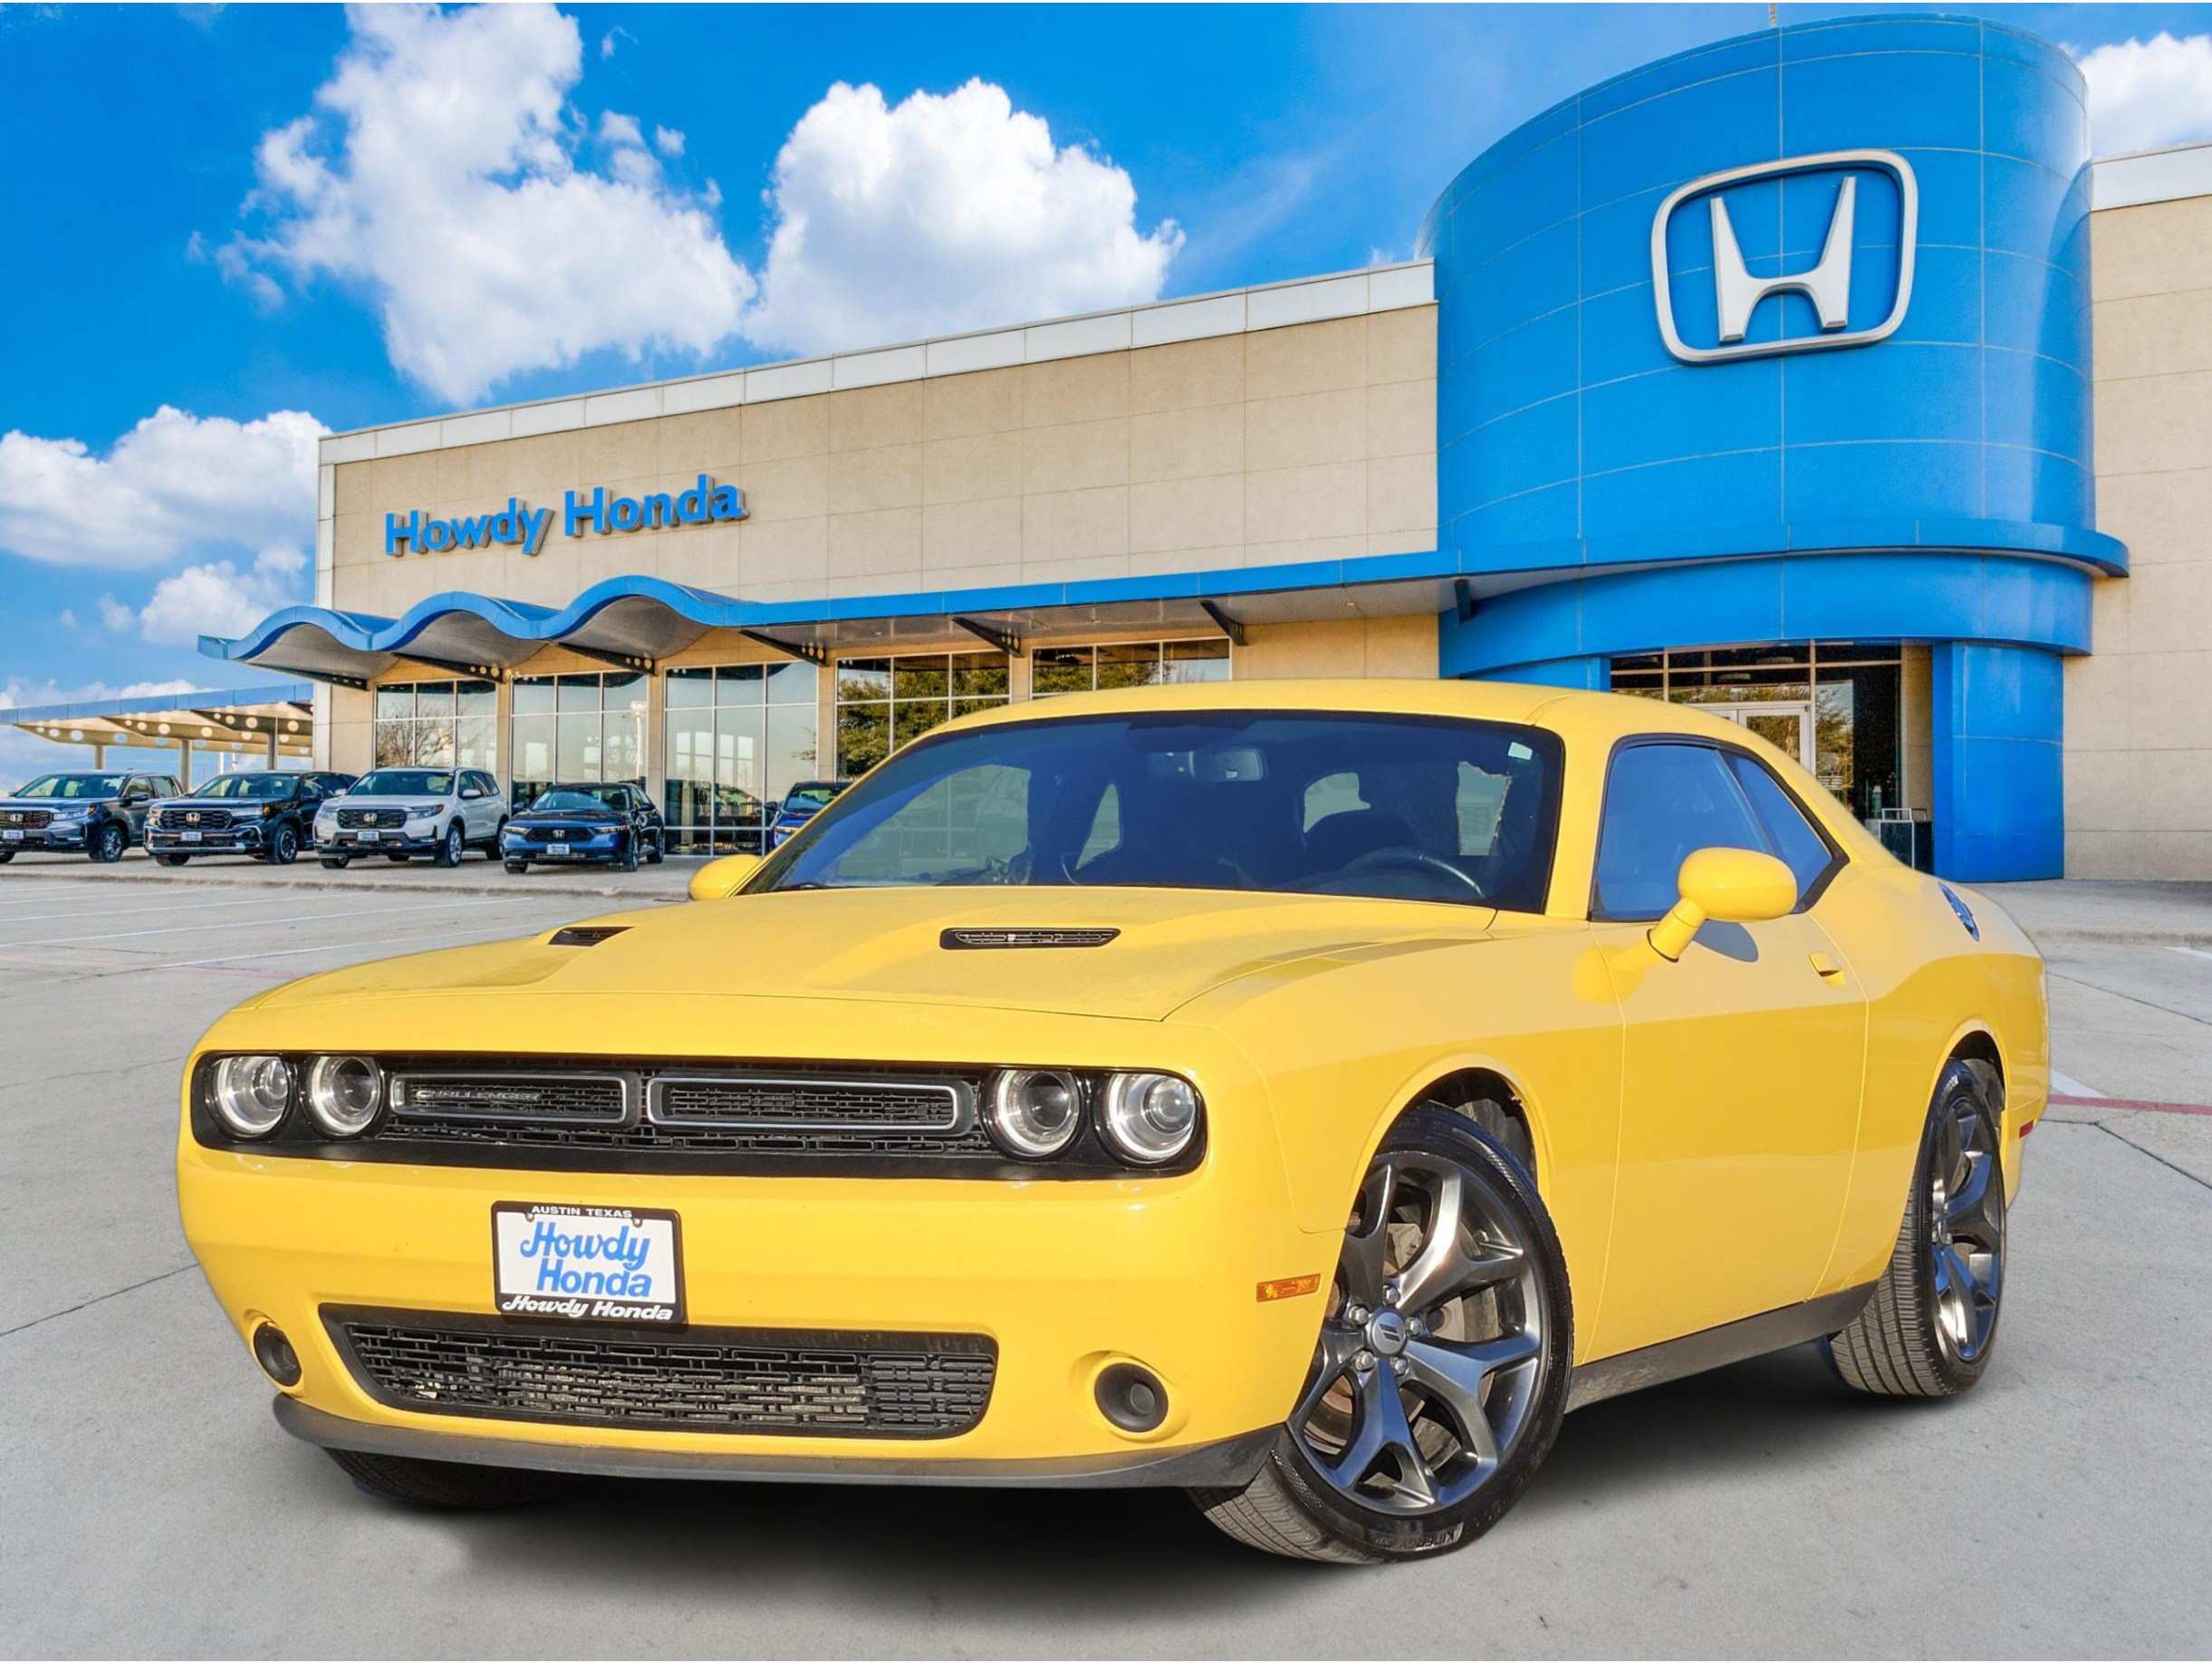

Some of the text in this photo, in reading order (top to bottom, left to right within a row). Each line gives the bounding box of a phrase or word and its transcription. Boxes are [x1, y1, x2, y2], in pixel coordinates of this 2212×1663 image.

[385, 474, 748, 556] Howdy Honda
[531, 1206, 632, 1218] AUSTIN TEXAS
[520, 1221, 650, 1271] Howdy
[536, 1257, 652, 1298] Honda
[502, 1295, 674, 1321] Howdy Honda
